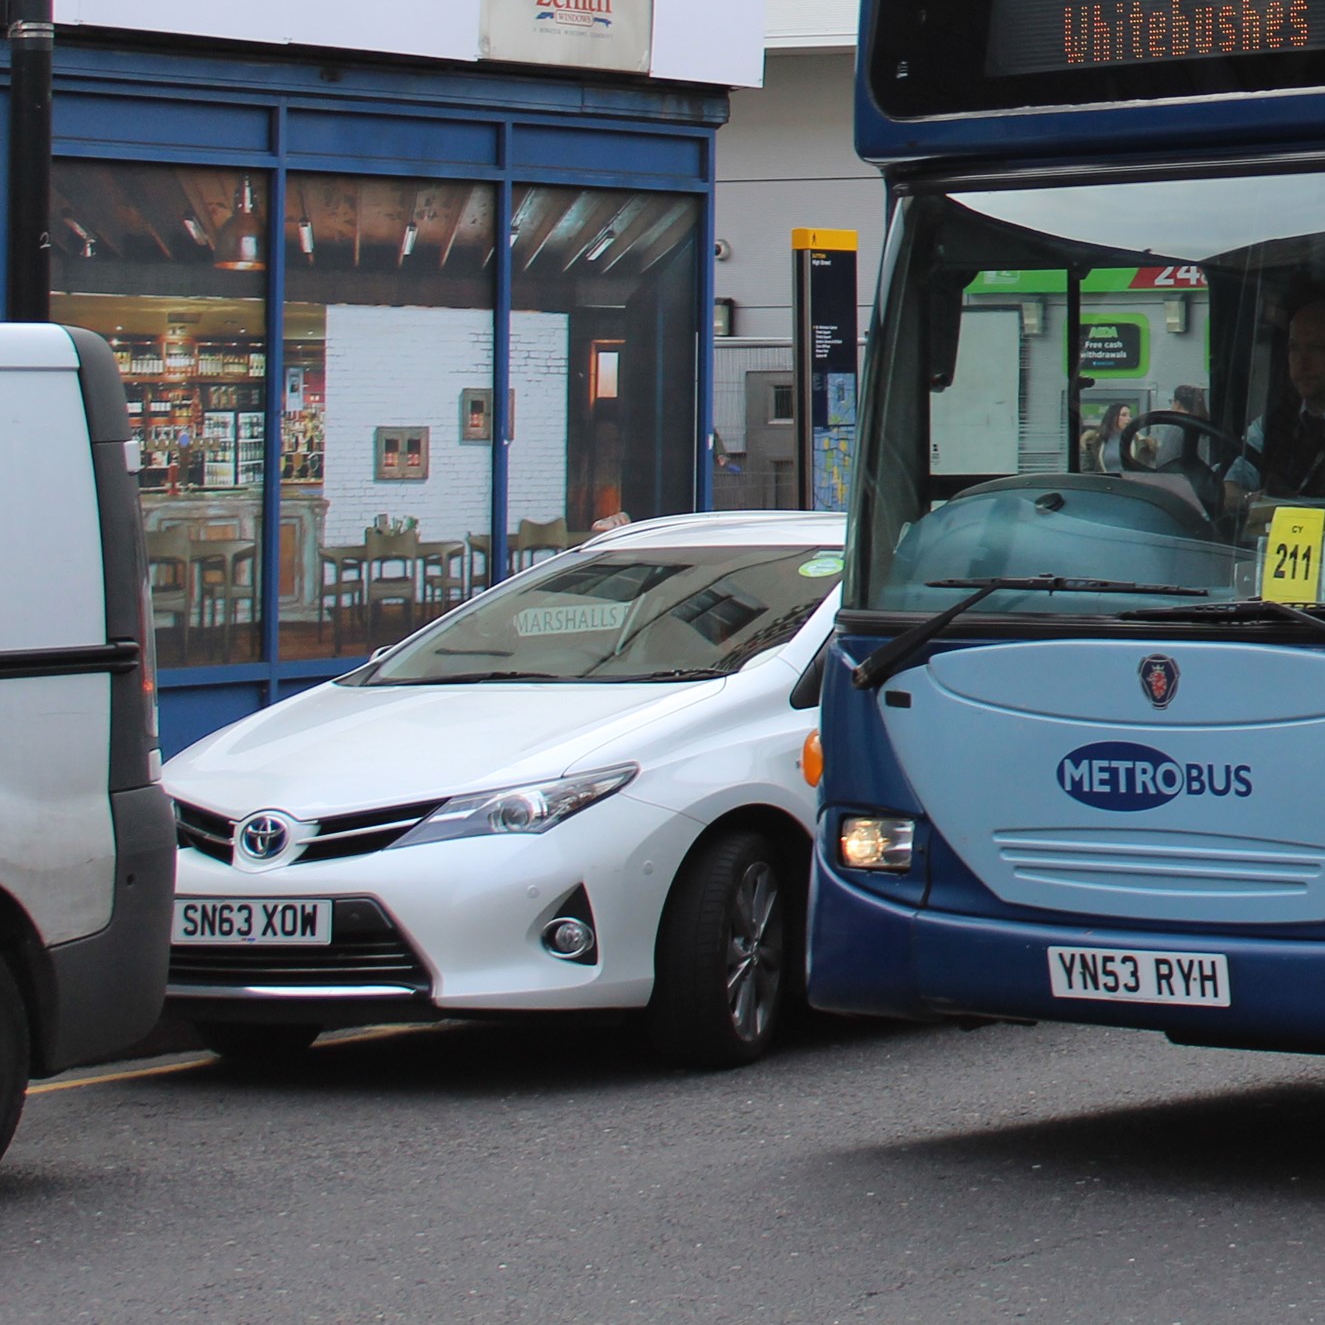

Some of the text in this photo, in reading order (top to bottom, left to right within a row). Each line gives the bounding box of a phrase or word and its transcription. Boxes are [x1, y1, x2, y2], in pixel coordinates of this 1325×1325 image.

[558, 13, 592, 23] WINDOWS
[1085, 340, 1123, 349] Free cash
[1291, 525, 1304, 534] CY
[1273, 543, 1312, 581] 211
[1064, 759, 1253, 798] METROBUS
[183, 904, 318, 937] SN63 XOW
[1058, 952, 1219, 999] YN53 RYH
